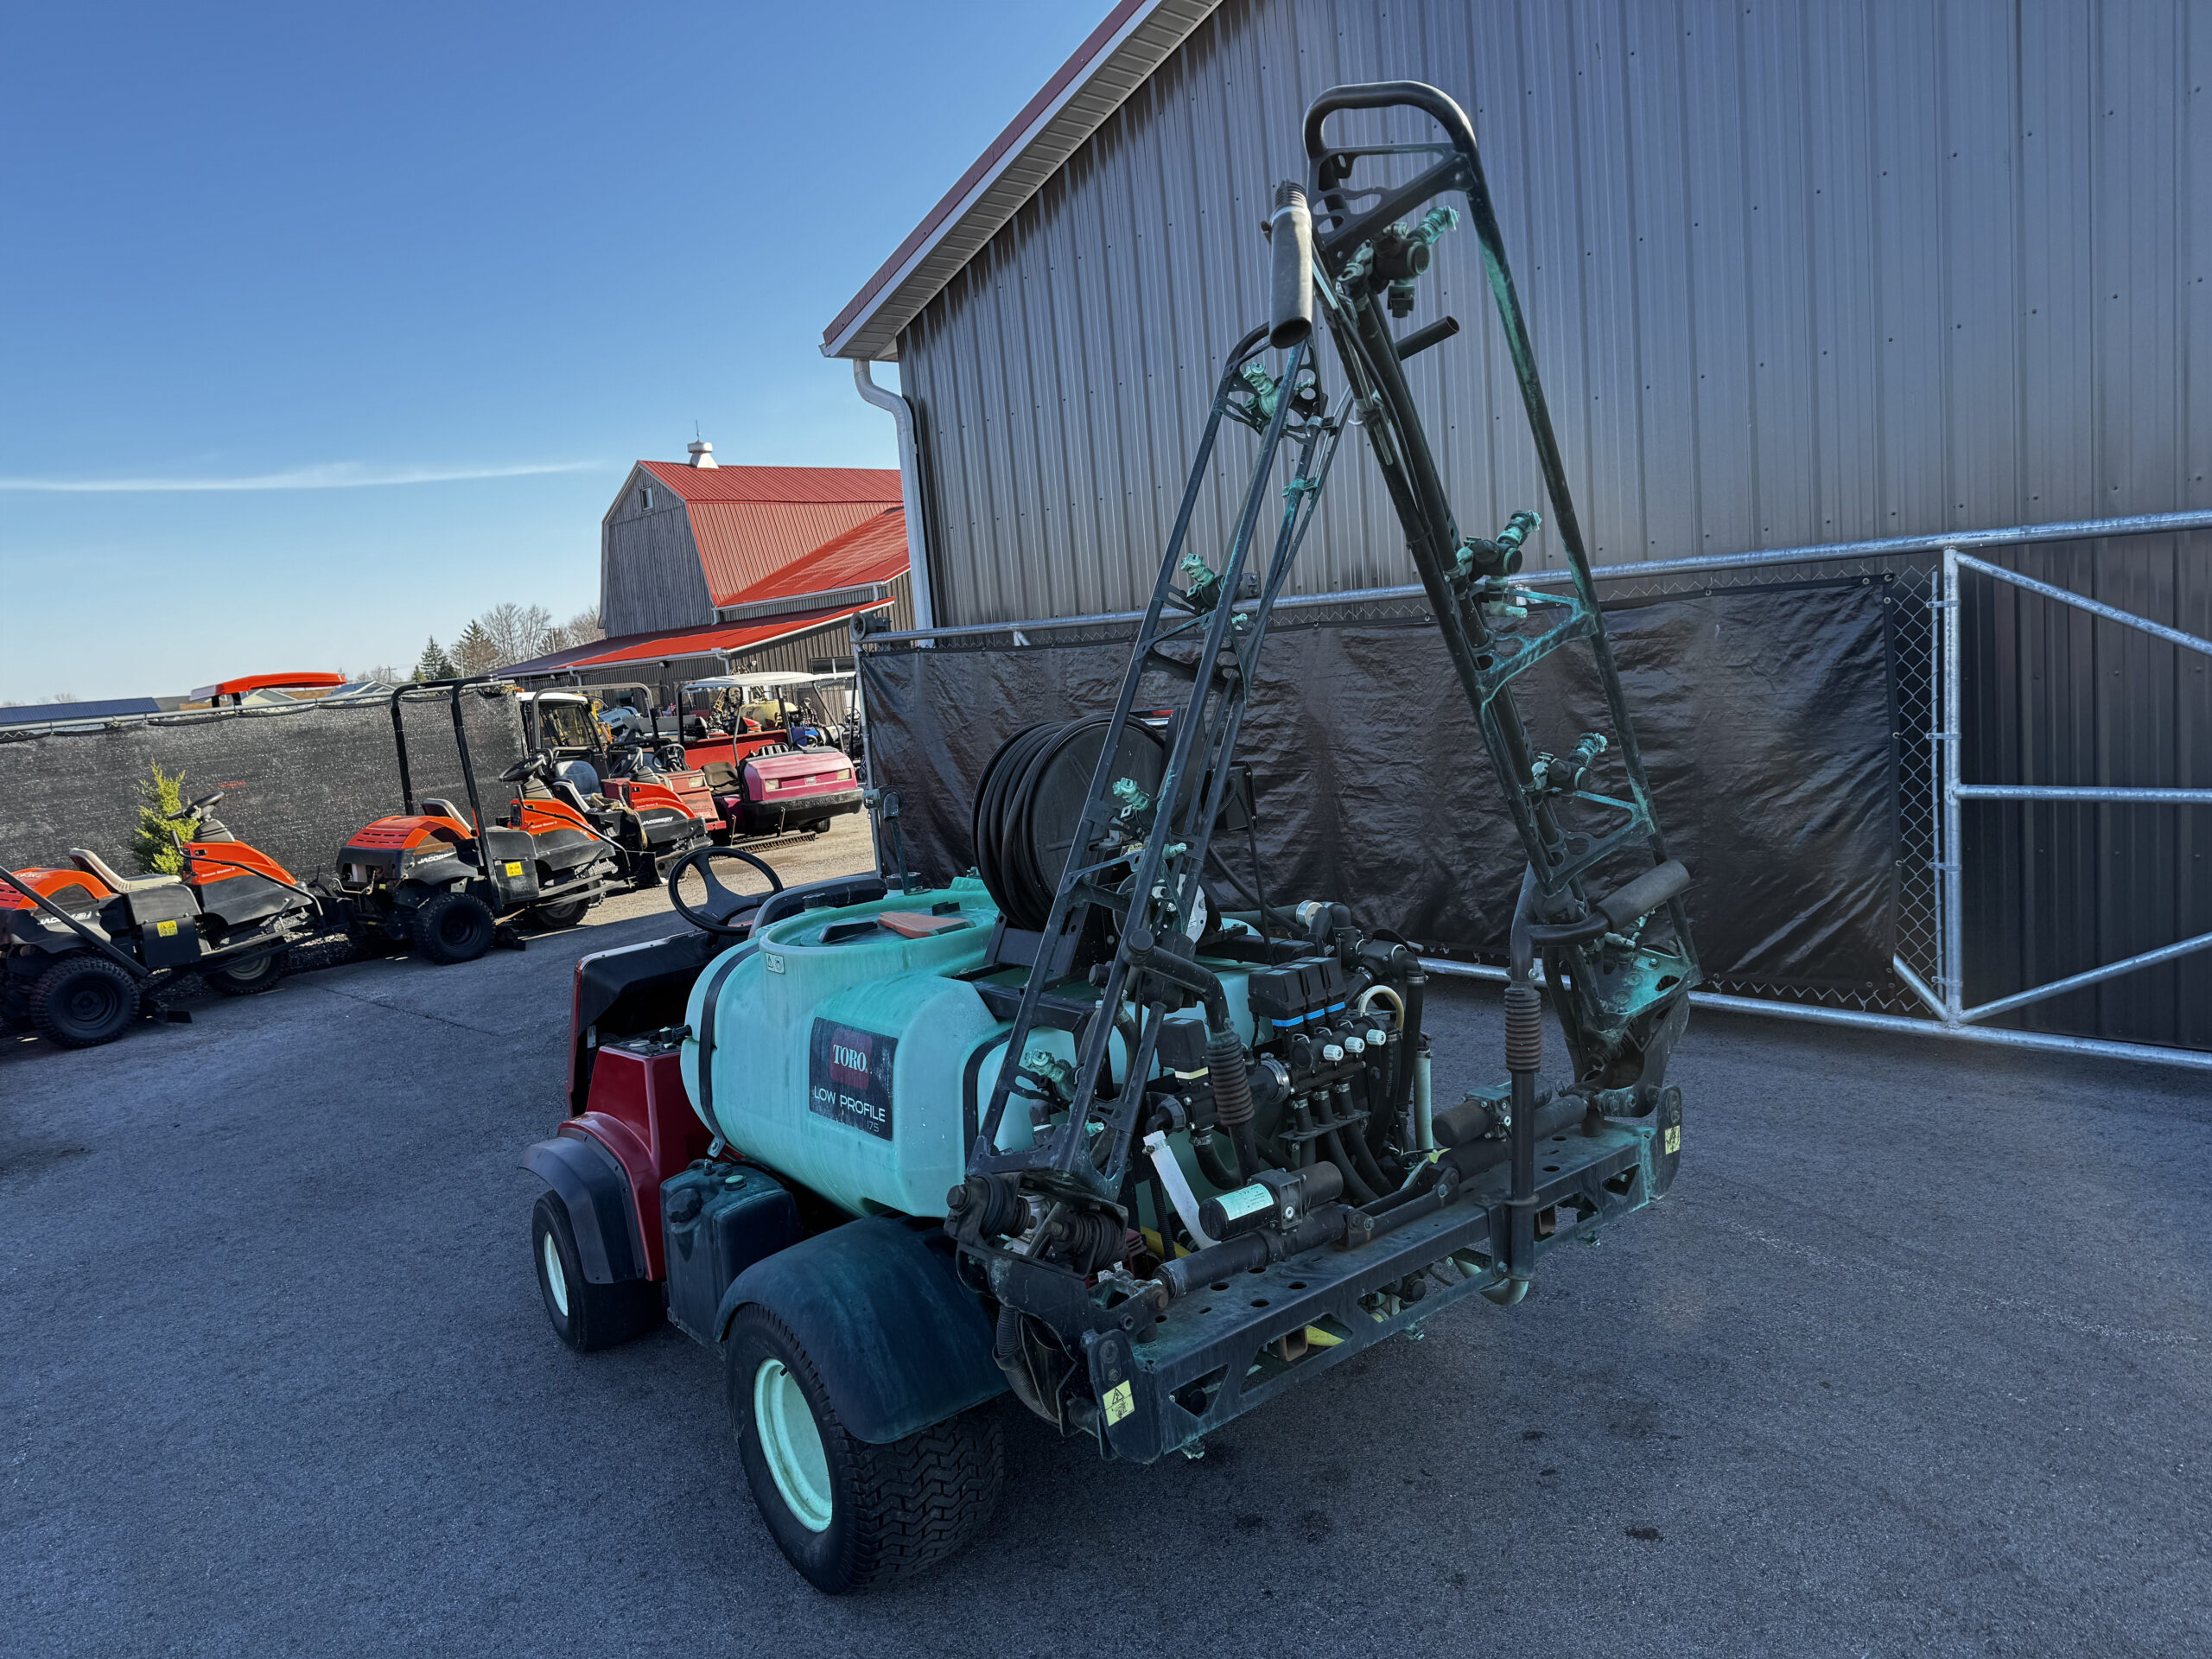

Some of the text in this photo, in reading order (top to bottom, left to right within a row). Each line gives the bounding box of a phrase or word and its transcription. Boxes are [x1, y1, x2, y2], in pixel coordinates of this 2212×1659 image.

[833, 1044, 867, 1072] TORO
[814, 1085, 886, 1123] LOW PROFILE
[867, 1119, 880, 1133] 175
